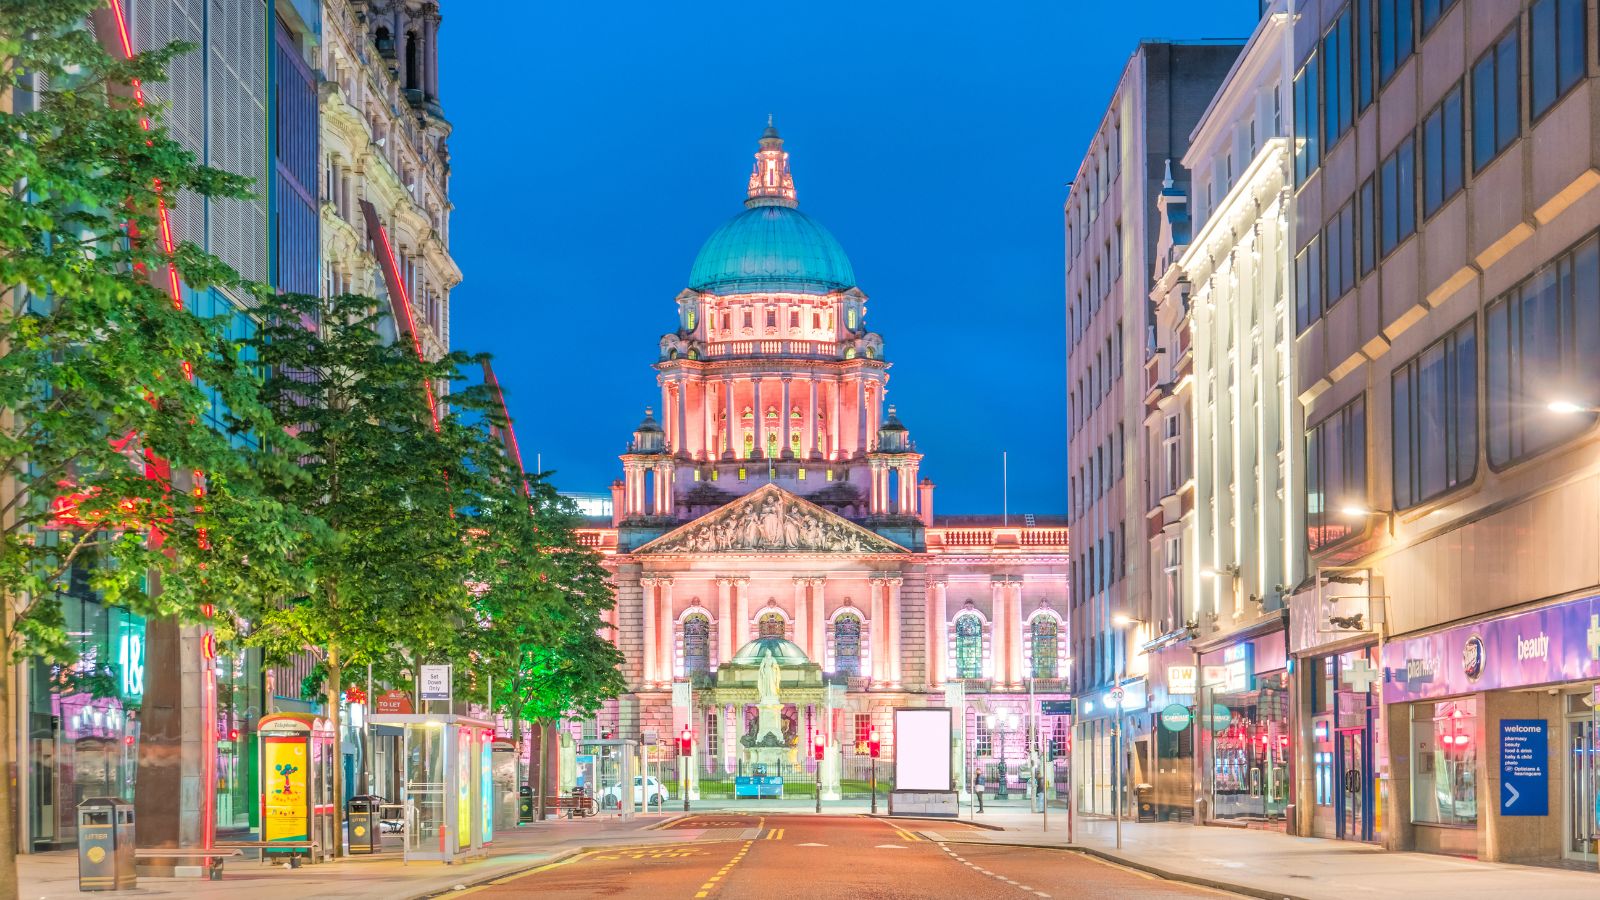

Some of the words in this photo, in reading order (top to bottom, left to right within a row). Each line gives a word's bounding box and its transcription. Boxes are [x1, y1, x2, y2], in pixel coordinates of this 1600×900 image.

[1517, 632, 1549, 662] beauty
[1171, 669, 1192, 680] DW
[1112, 691, 1123, 699] 20
[84, 832, 108, 840] LITTER
